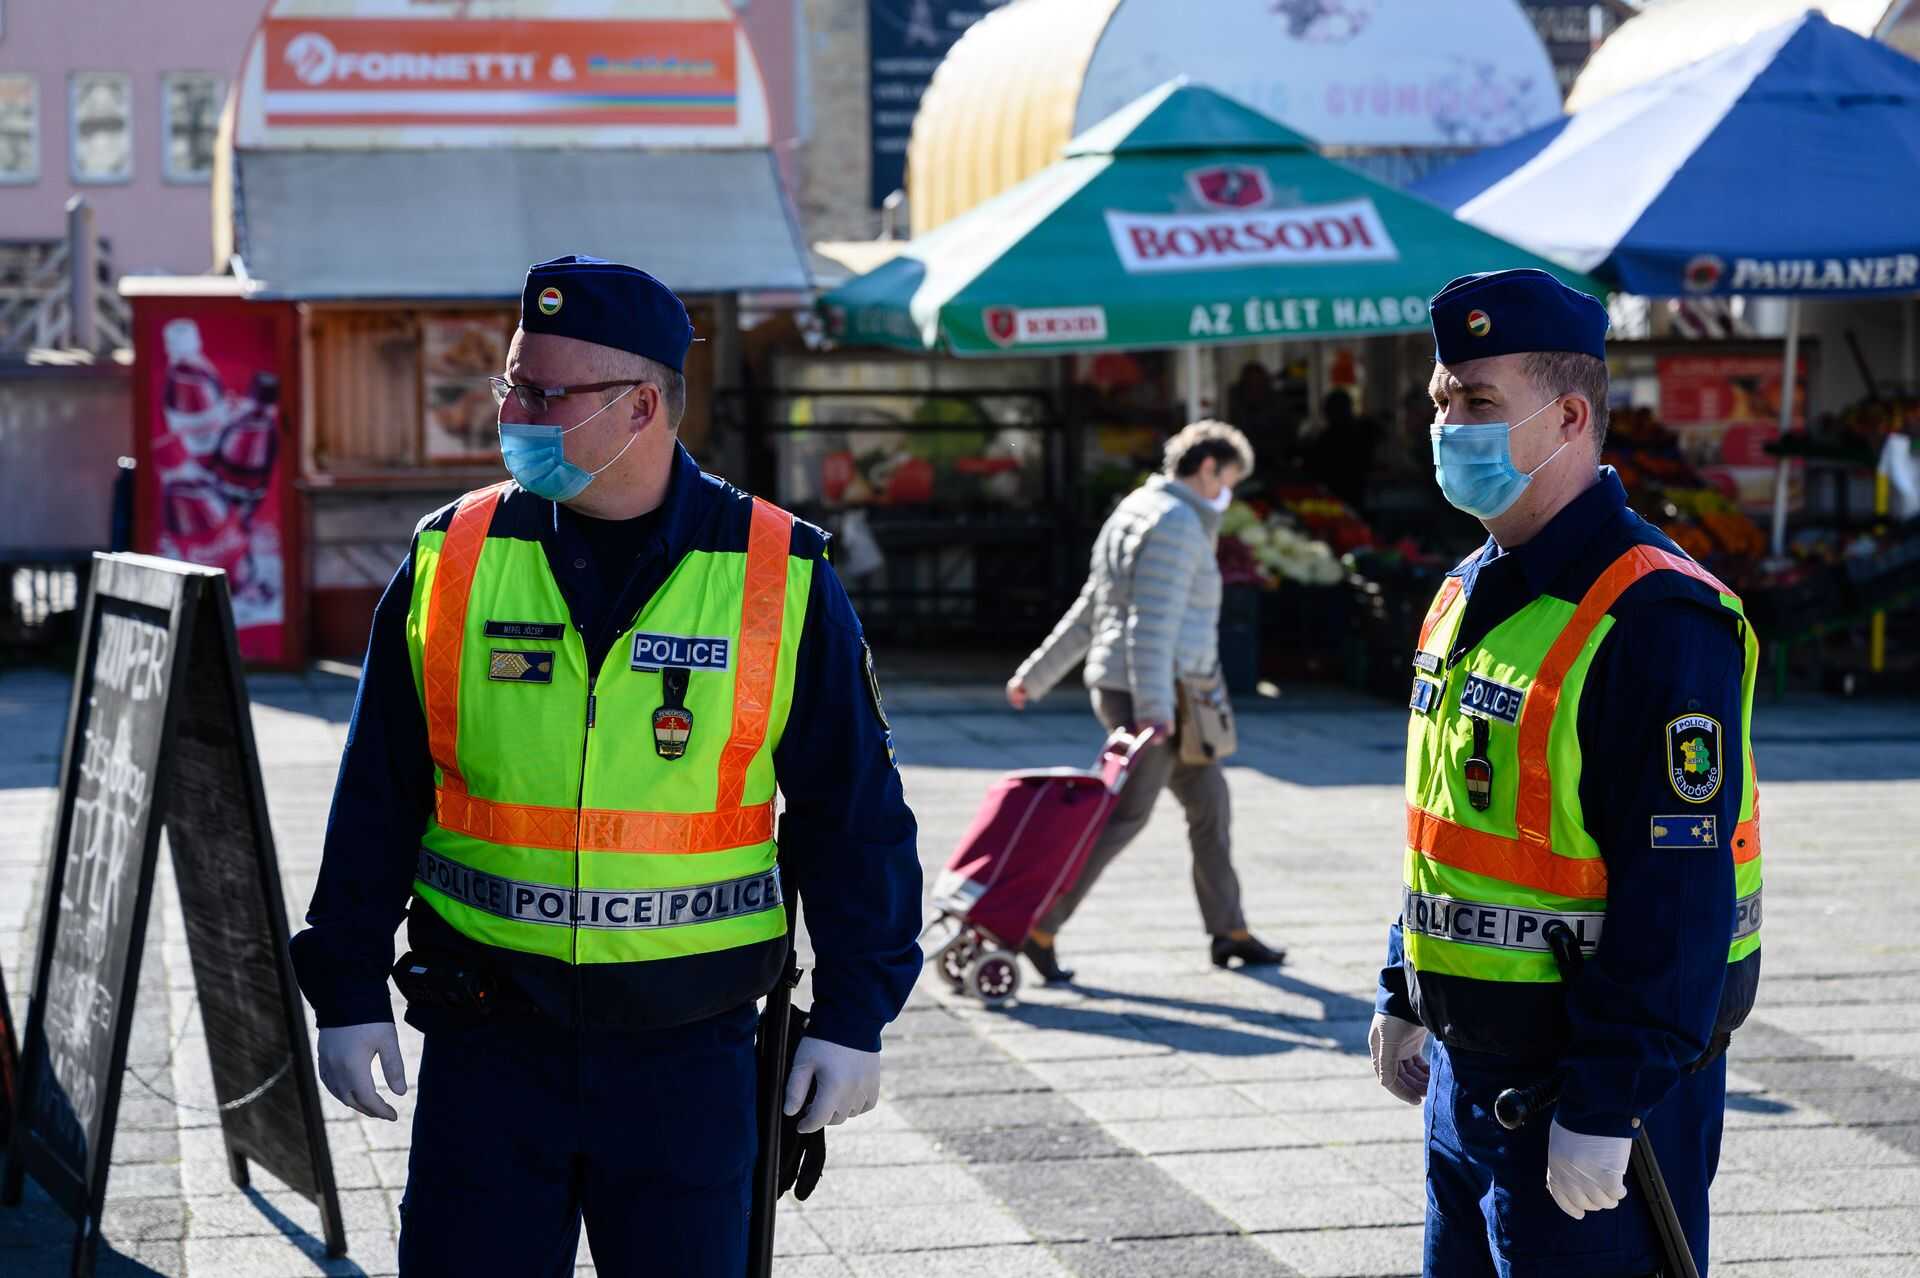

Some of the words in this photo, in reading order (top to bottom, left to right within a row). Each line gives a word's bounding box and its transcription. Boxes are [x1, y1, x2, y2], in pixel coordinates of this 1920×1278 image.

[337, 53, 536, 81] FORNETTI
[549, 54, 575, 81] &
[1128, 214, 1374, 260] BORSODI
[1732, 254, 1918, 289] PAULANER
[1188, 303, 1233, 336] AZ
[1245, 296, 1320, 332] ÉLET
[1332, 296, 1430, 329] HABO
[636, 638, 726, 665] POLICE
[1462, 680, 1519, 718] POLICE
[1679, 719, 1709, 730] POLICE
[1674, 767, 1718, 797] RENDŐRSÉG
[426, 855, 499, 909] POLICE
[515, 888, 653, 924] POLICE
[669, 875, 775, 920] POLICE
